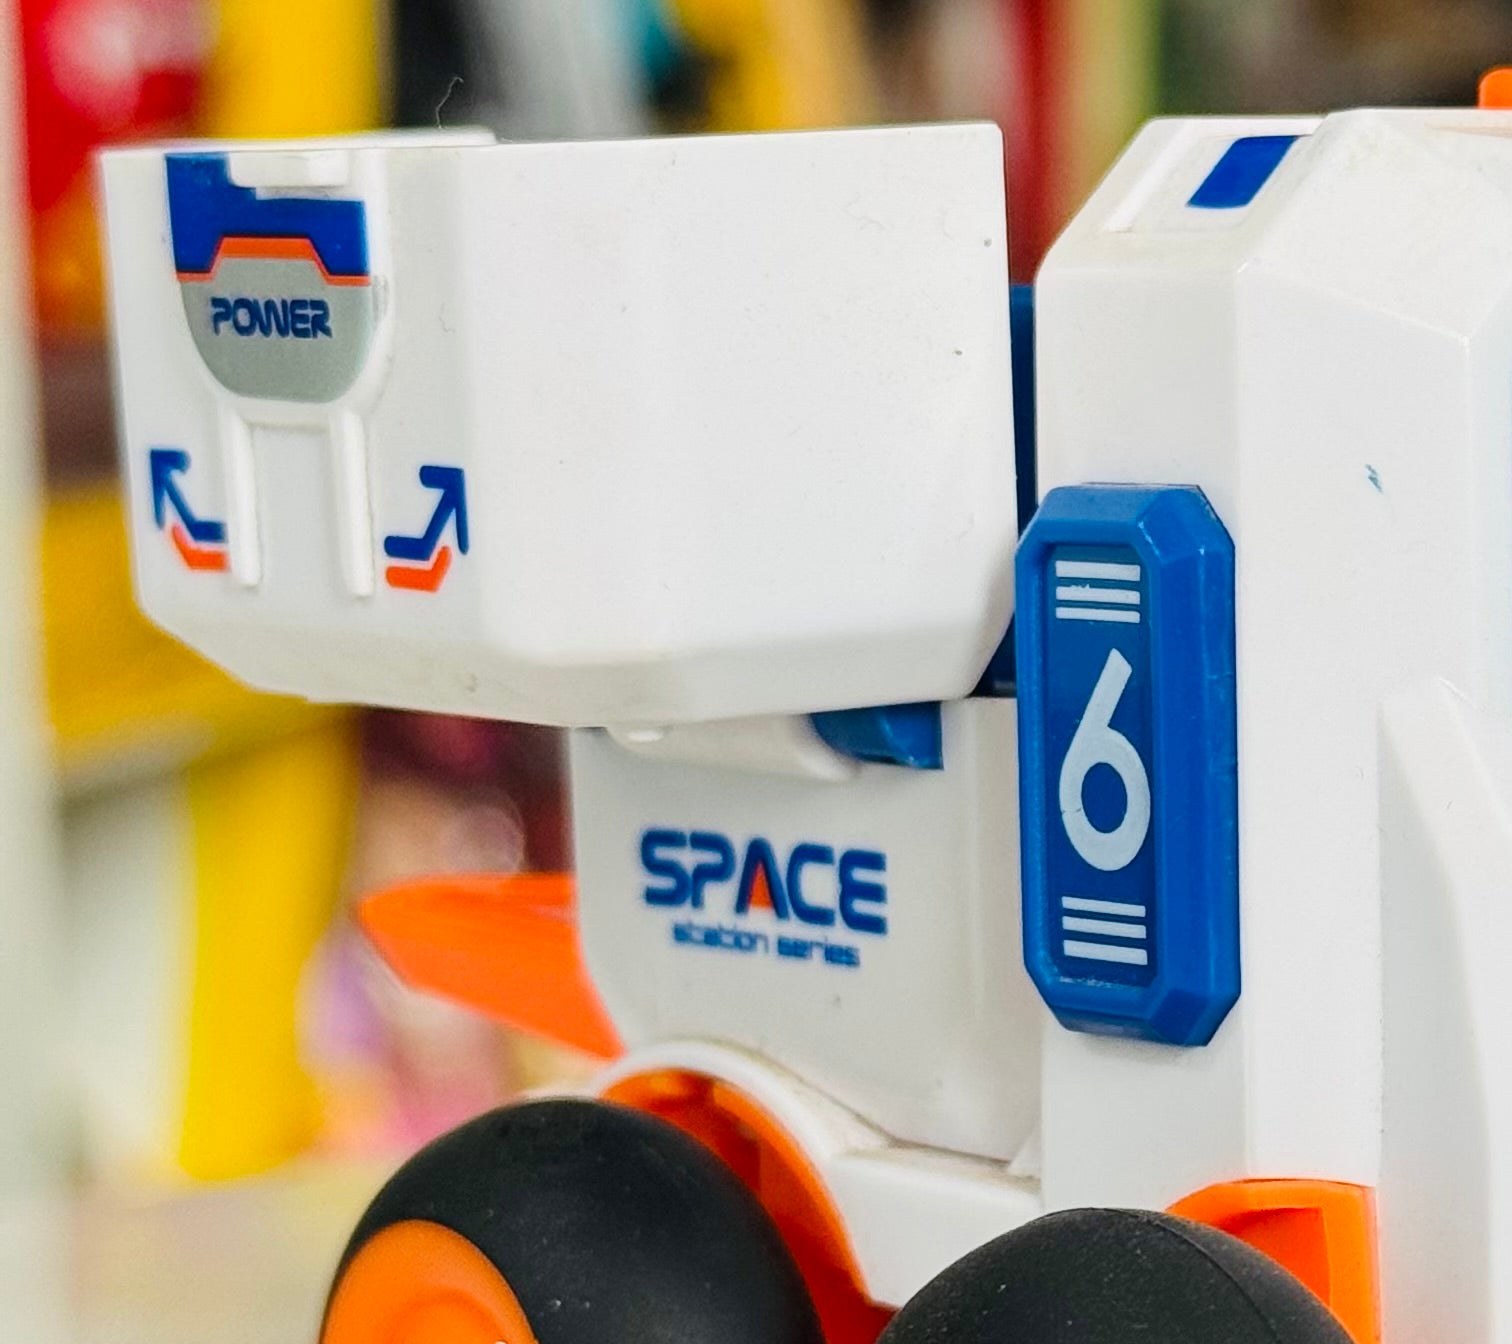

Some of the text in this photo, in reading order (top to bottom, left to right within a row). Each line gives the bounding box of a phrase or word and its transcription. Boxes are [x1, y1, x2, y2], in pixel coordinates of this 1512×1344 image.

[210, 296, 333, 339] POWER
[1059, 647, 1151, 872] 6
[640, 827, 889, 936] SPACE
